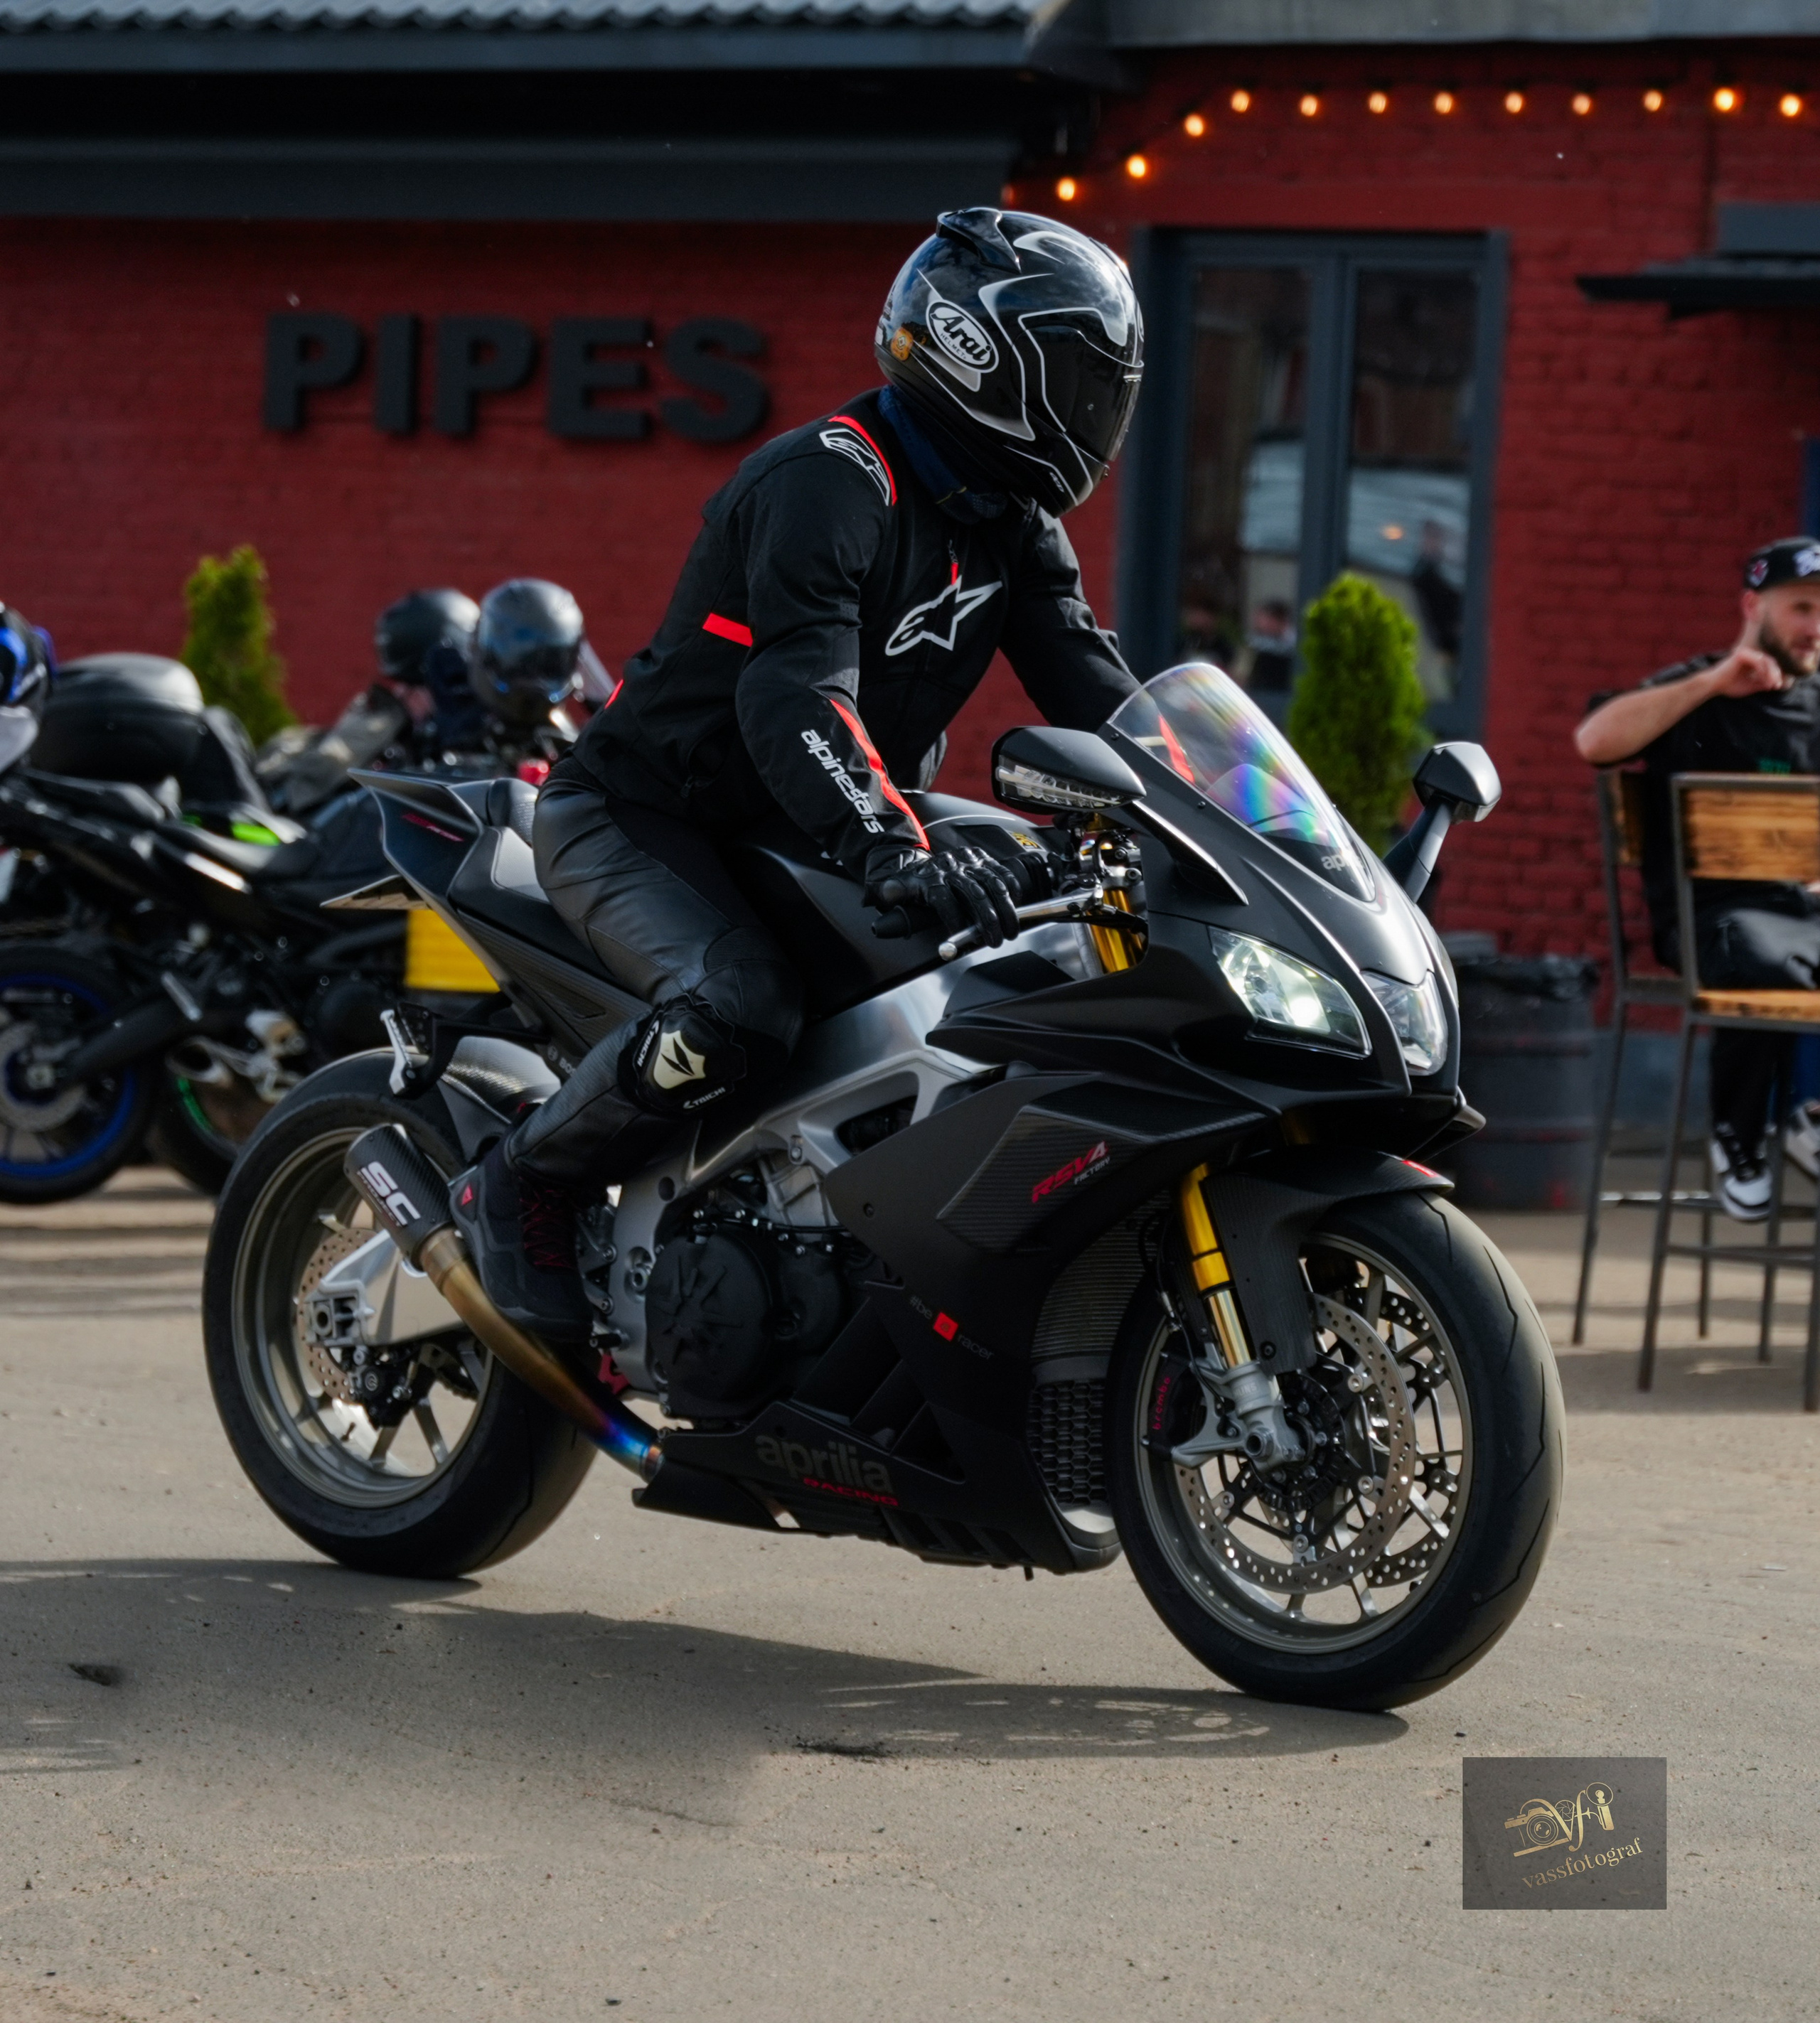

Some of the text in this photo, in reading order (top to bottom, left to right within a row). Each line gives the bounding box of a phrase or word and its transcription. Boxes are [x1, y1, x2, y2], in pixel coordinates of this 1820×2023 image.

[930, 313, 992, 361] Arai
[940, 333, 965, 357] HELMET
[264, 313, 770, 444] PIPES
[801, 729, 884, 833] alpinestars
[360, 1161, 421, 1225] SC
[1032, 1141, 1108, 1203] RSV4
[910, 1296, 933, 1319] #be
[958, 1334, 995, 1360] racer
[1152, 1377, 1171, 1430] brembo
[756, 1435, 893, 1493] aprilia
[803, 1477, 899, 1507] RACING
